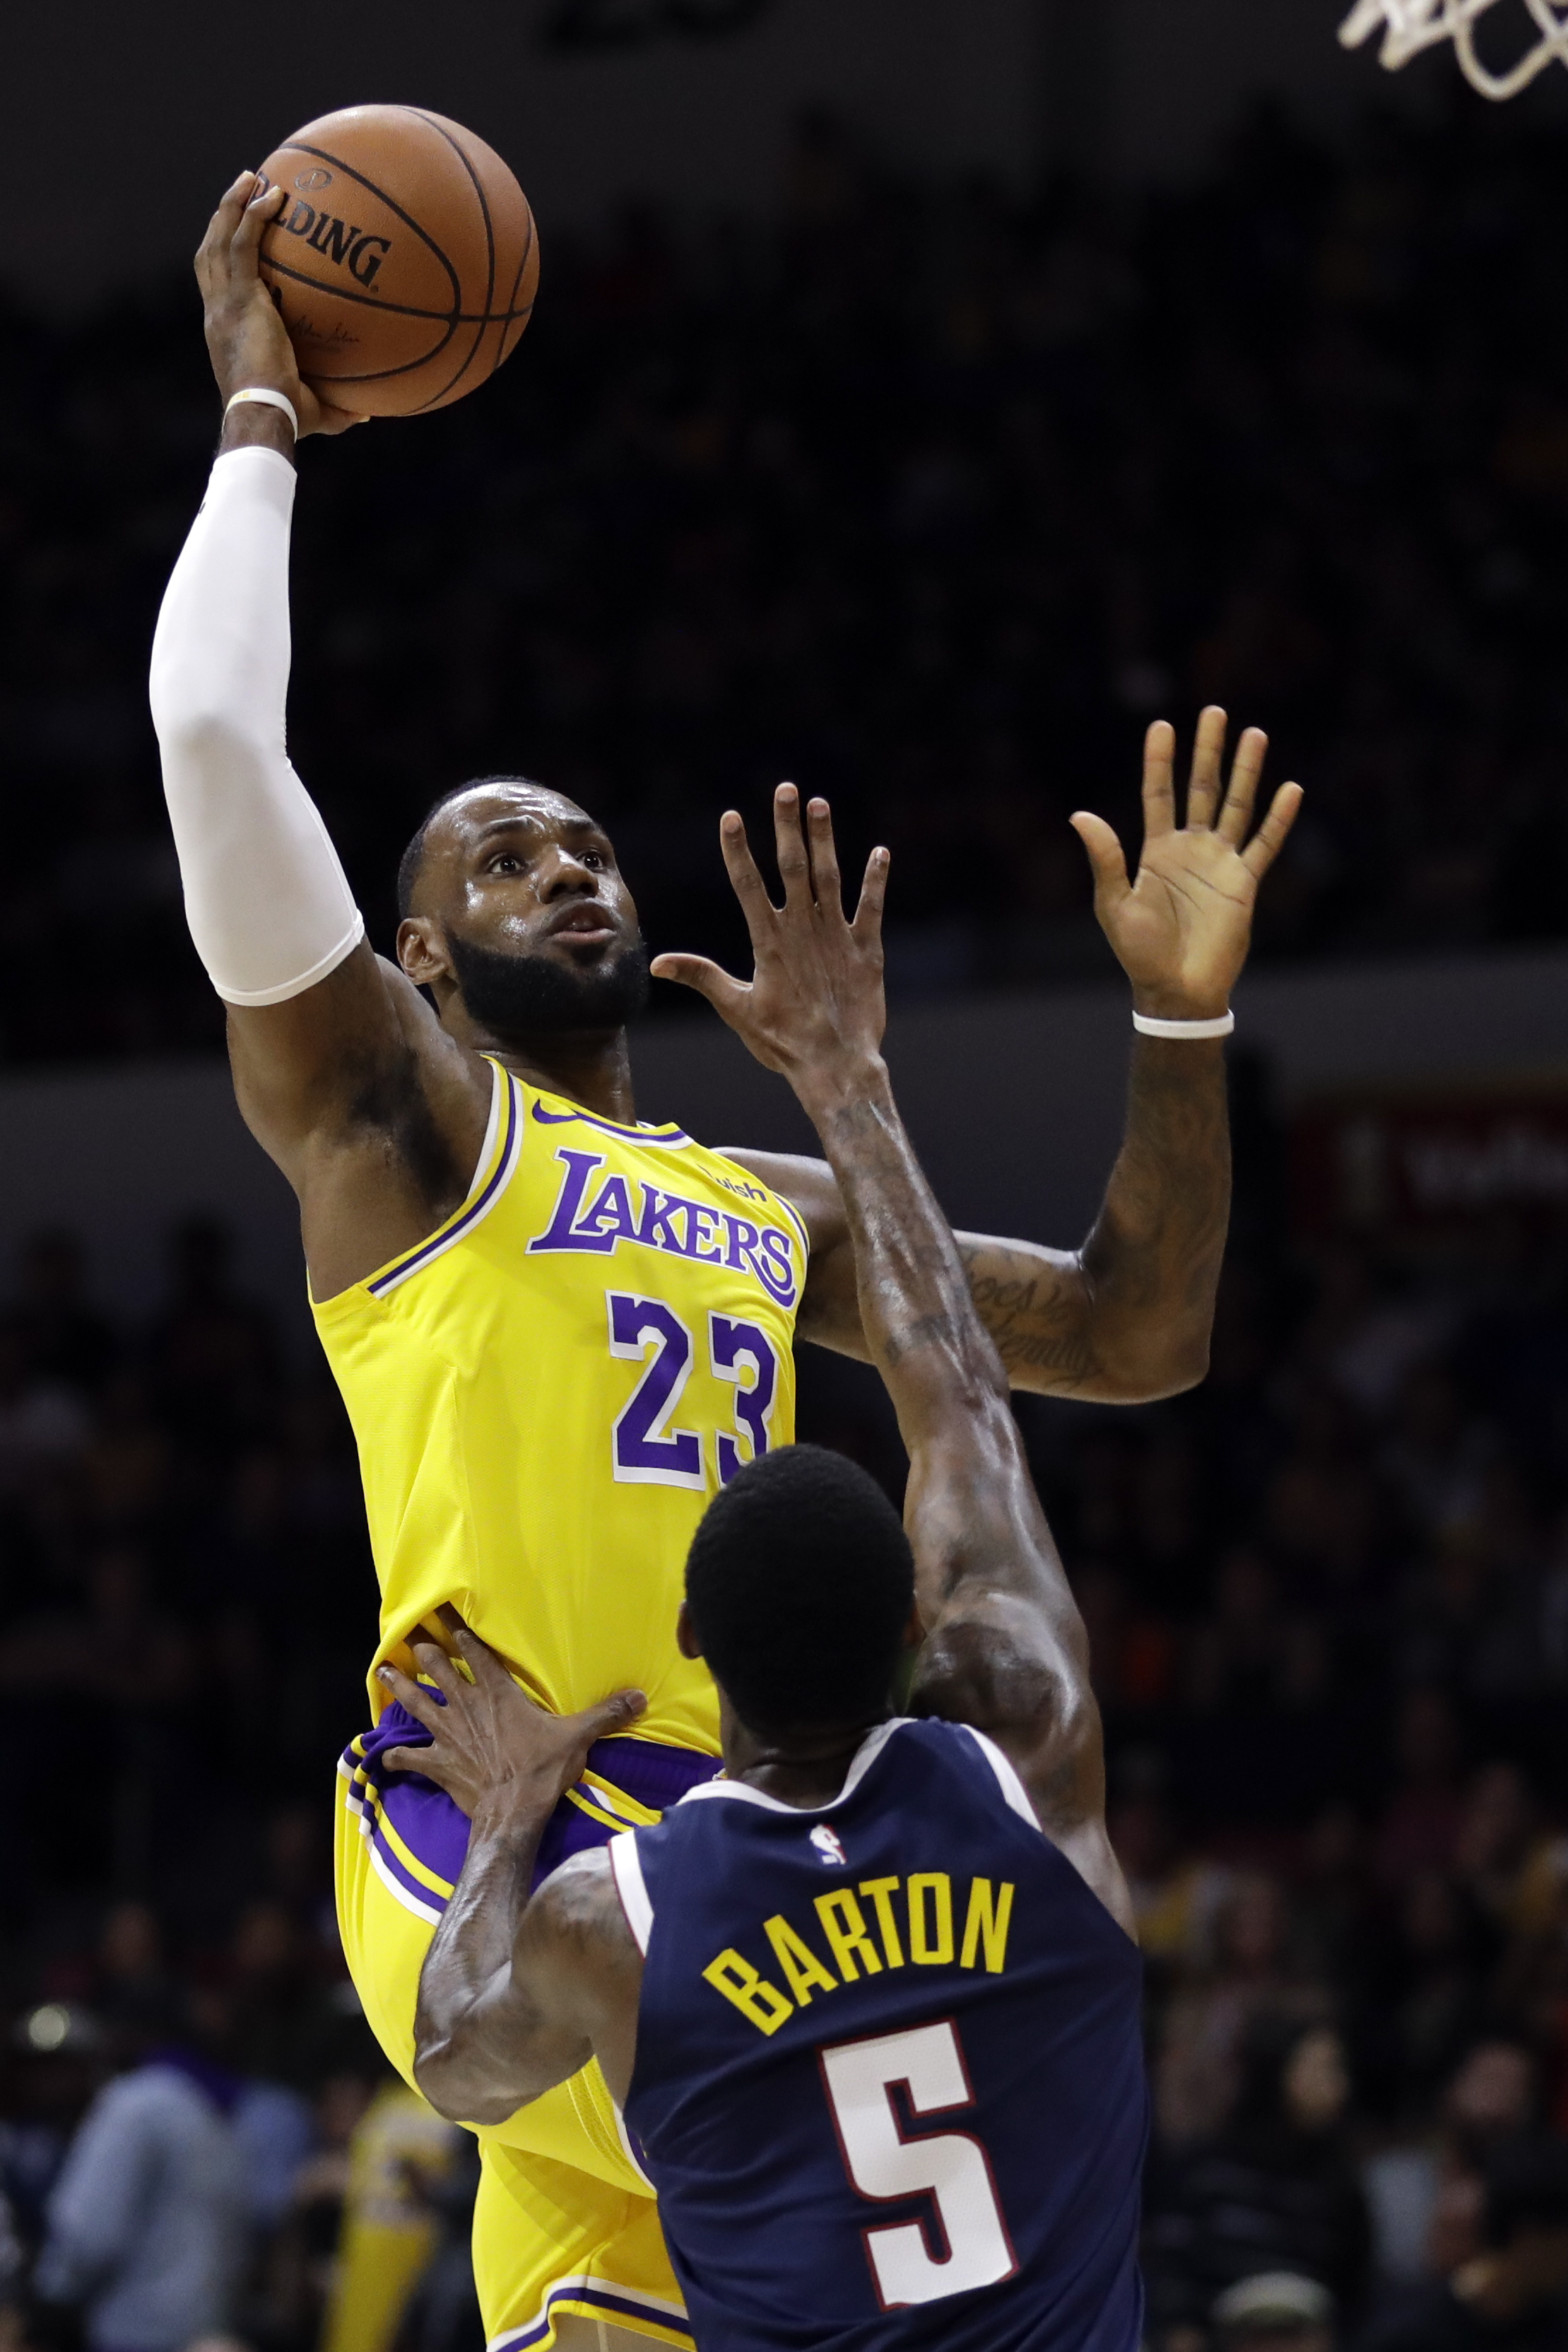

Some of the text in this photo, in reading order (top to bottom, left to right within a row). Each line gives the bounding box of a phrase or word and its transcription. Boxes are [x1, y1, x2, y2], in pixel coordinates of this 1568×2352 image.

[249, 171, 391, 288] PLDING
[525, 1146, 797, 1310] LAKERS
[606, 1290, 779, 1491] 23
[702, 1872, 1015, 2036] BARTON
[818, 2017, 1019, 2312] 5
